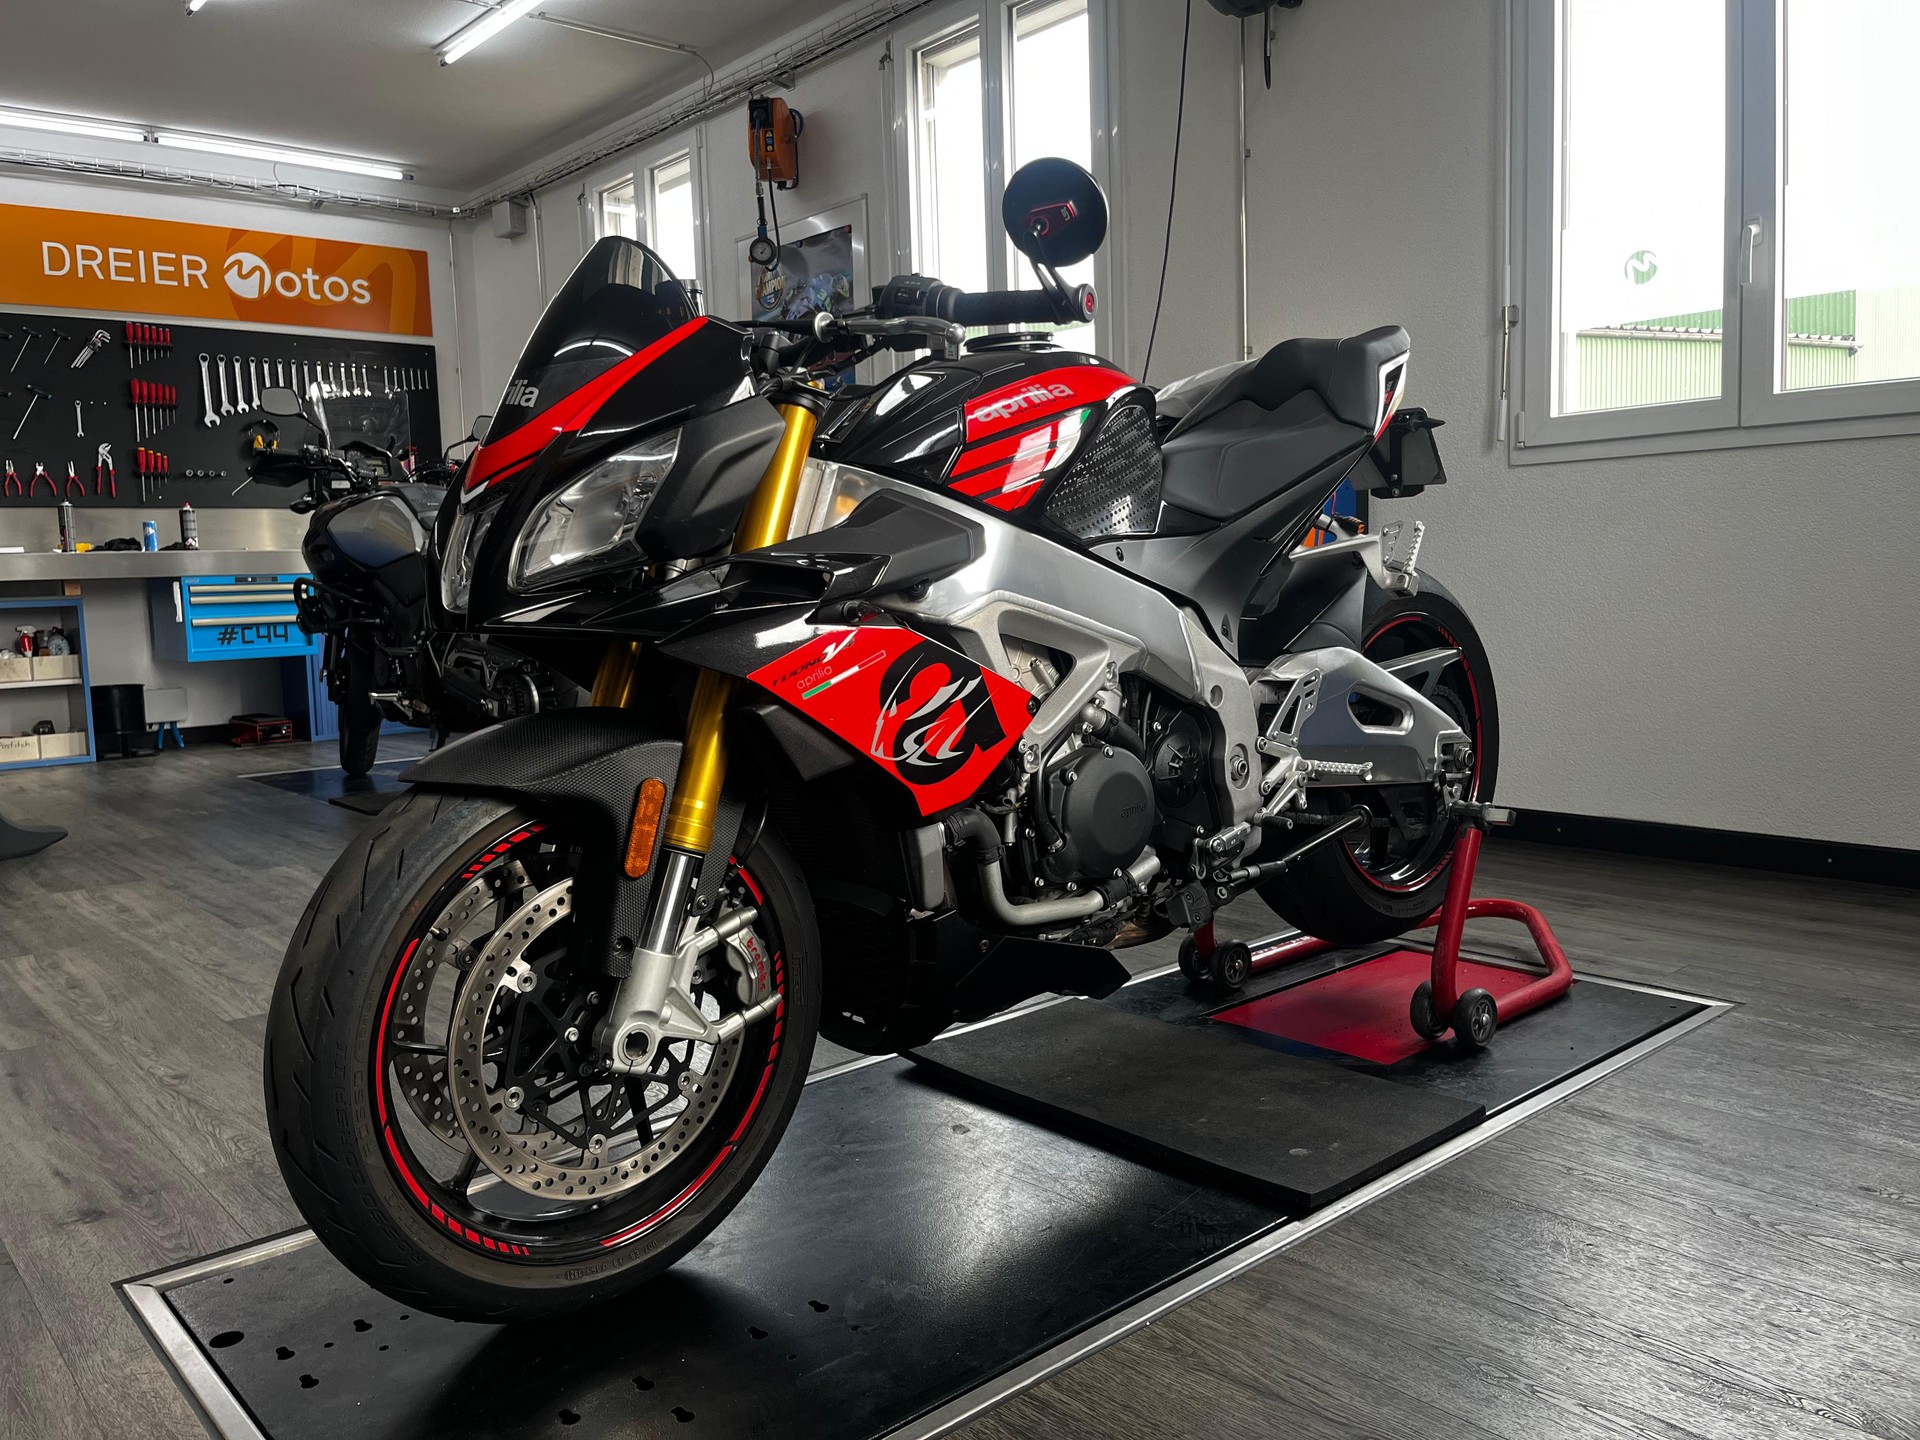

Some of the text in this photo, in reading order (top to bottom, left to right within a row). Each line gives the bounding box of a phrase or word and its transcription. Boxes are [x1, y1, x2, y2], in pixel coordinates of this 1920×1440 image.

[41, 240, 372, 305] DREIER Motos
[505, 379, 540, 409] ilia
[973, 383, 1076, 423] aprilia
[216, 624, 289, 645] #C44
[796, 665, 834, 691] aprilia
[746, 936, 766, 993] brembo
